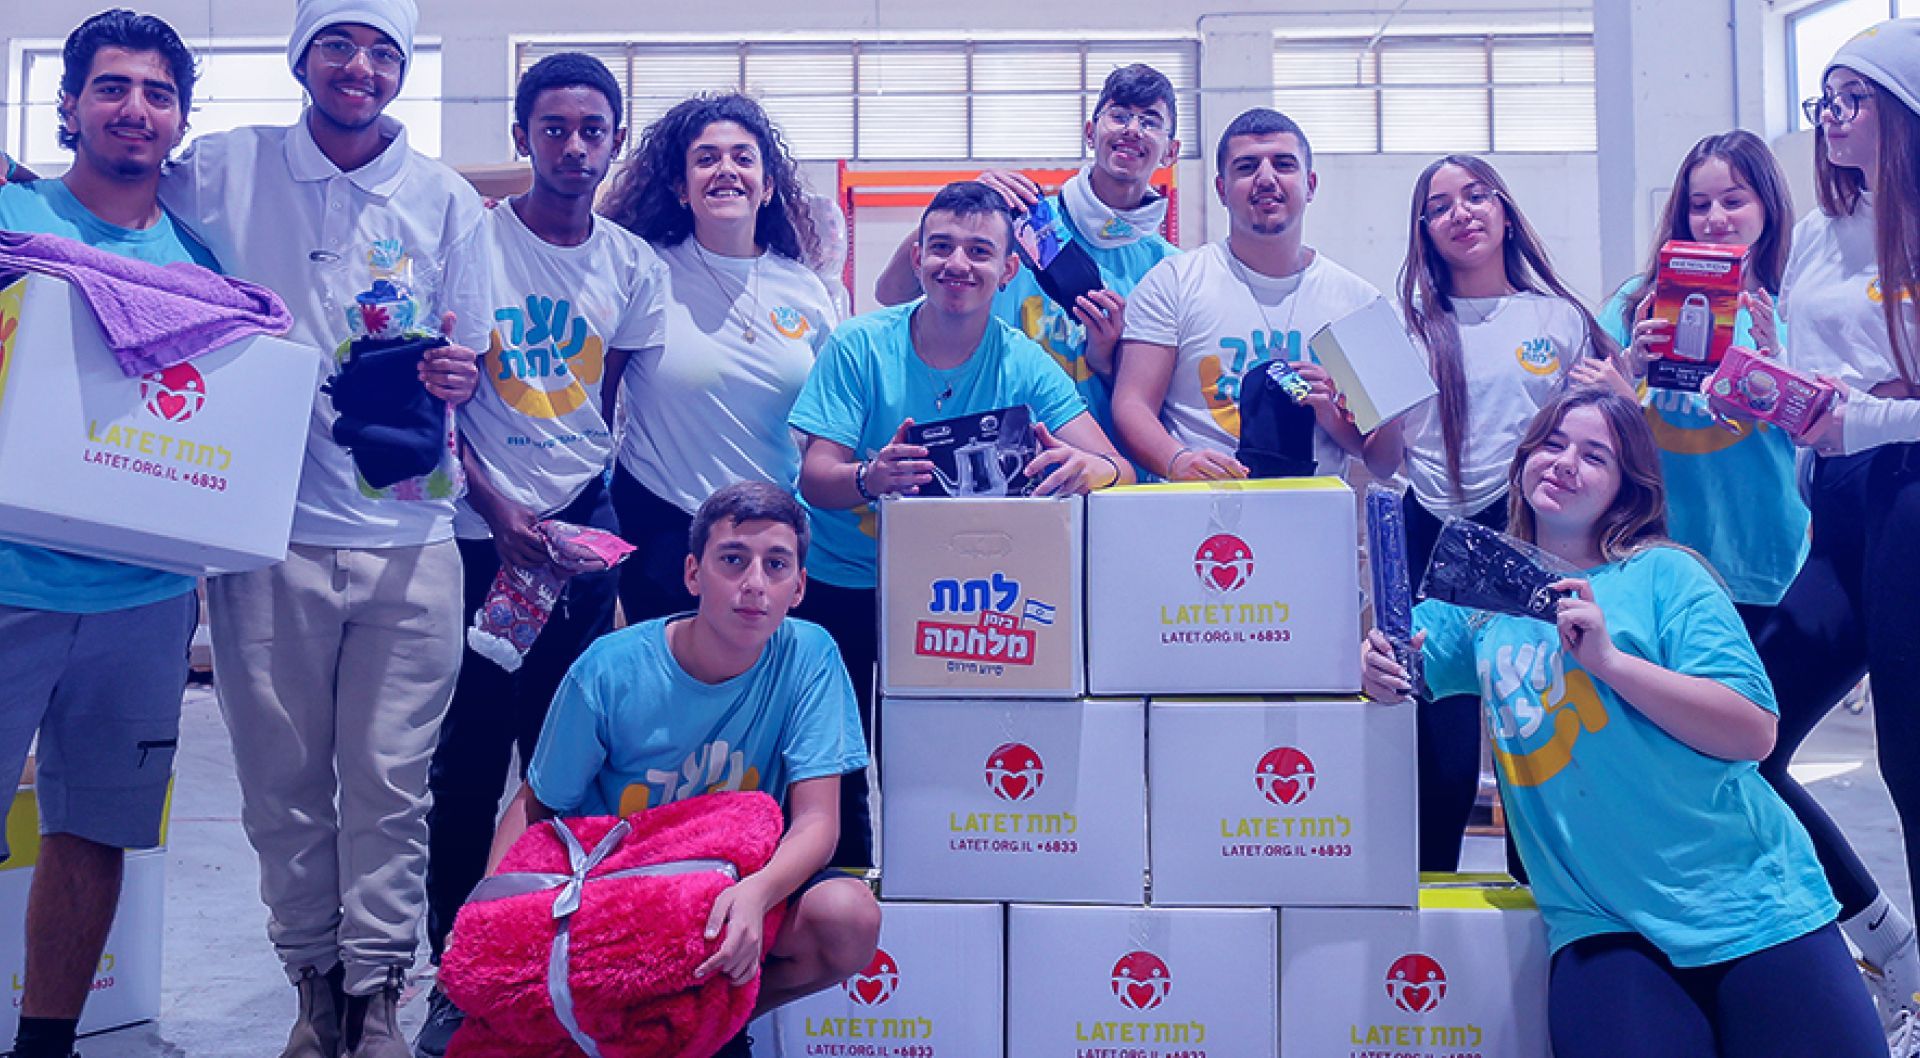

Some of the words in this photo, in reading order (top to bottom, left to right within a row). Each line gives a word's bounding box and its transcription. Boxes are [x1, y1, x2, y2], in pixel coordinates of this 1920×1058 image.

[88, 420, 175, 457] LATET
[930, 572, 1019, 613] לתת
[1161, 605, 1235, 625] LATET
[922, 627, 1028, 660] מלחמה
[950, 812, 1022, 833] LATET
[1220, 818, 1296, 838] LATET
[805, 1017, 880, 1038] LATET
[1076, 1021, 1150, 1042] LATET
[1351, 1025, 1426, 1046] LATET
